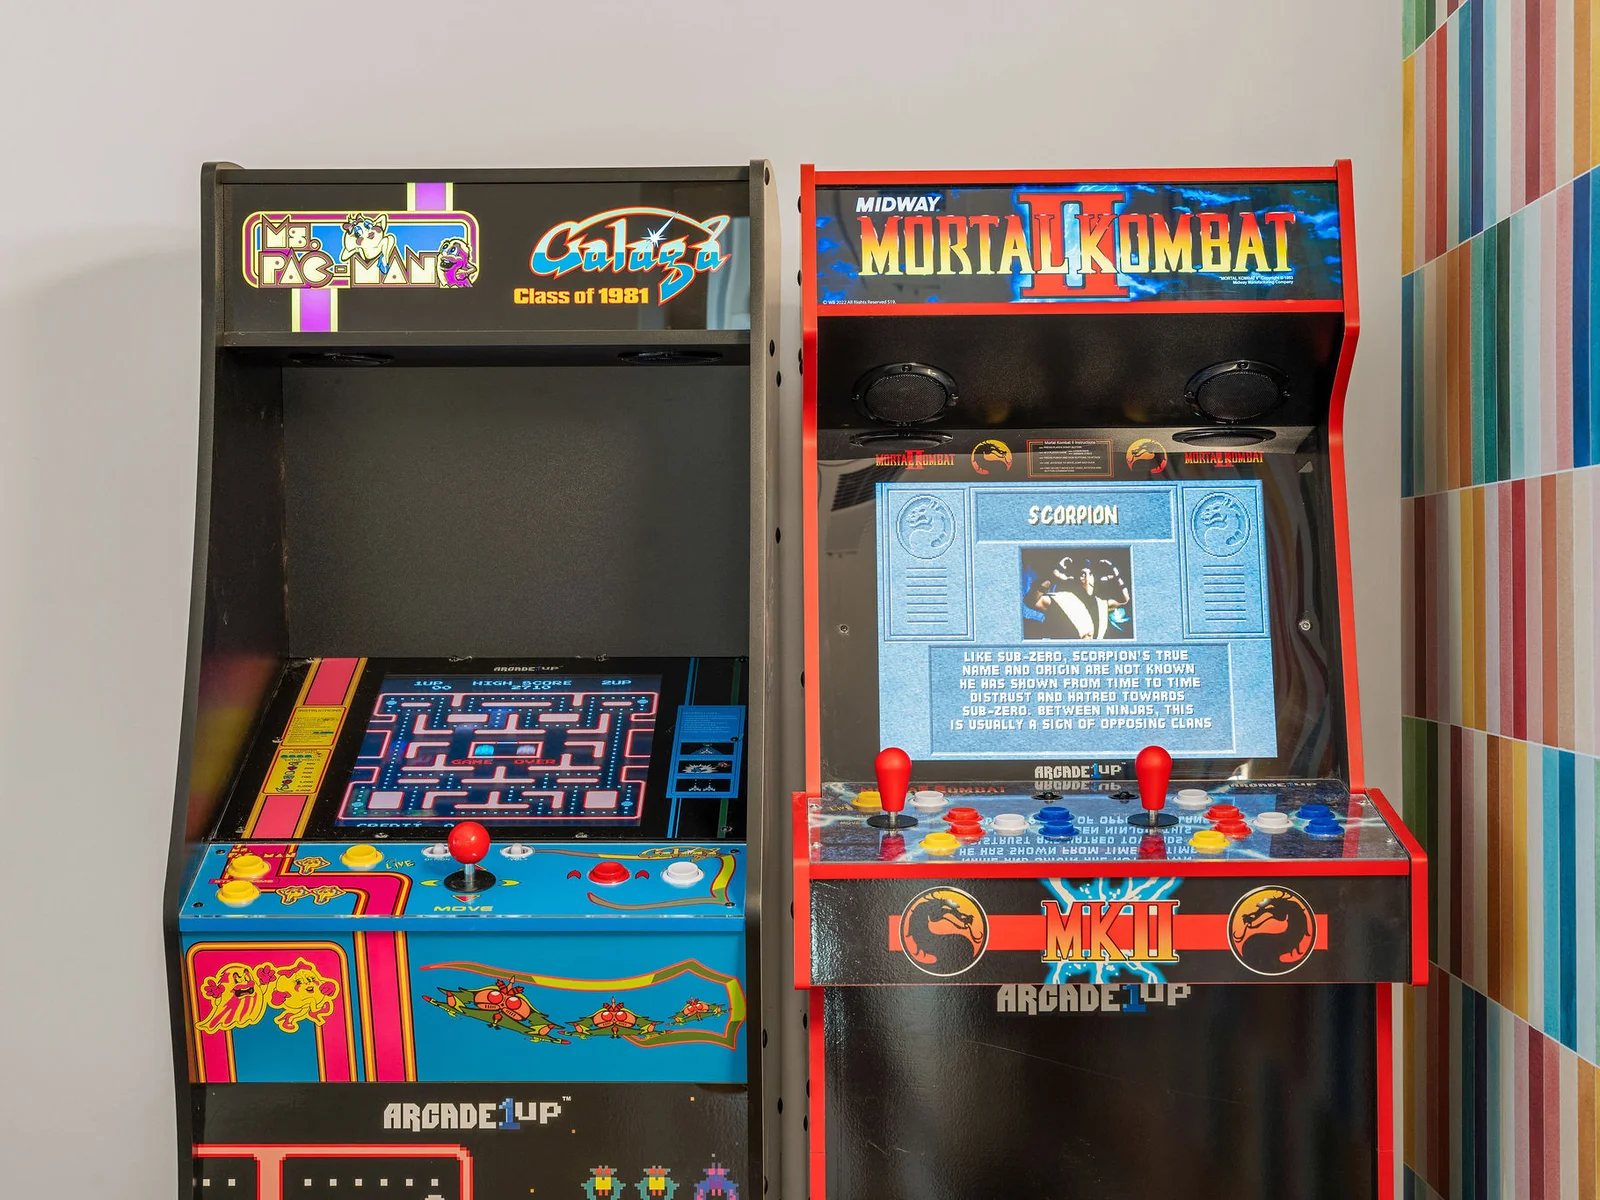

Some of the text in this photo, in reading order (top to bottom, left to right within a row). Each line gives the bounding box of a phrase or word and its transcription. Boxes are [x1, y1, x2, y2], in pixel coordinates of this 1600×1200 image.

[855, 197, 940, 213] MIDWAY
[857, 211, 1296, 277] MORTAL KOMBAT
[530, 206, 731, 306] Galaga
[258, 245, 439, 288] PAC-MAN
[514, 287, 649, 306] Class of 1981
[875, 453, 956, 466] MORTAL KOMBAT
[1184, 451, 1265, 464] MORTAL KOMBAT
[1027, 504, 1120, 526] SCORPION
[963, 650, 1189, 664] LIKE SUB-ZERO, SCORPION'S TRUE
[962, 663, 1195, 676] NAME AND ORIGIN ARE NOT KNOWN
[960, 677, 1201, 690] HE HAS SHOWN FROM TIME TO TIME
[970, 690, 1185, 703] DISTRUST AND HATRED TOWARDS
[962, 704, 1195, 717] SUB-ZERO. BETWEEN NINJAS, THIS
[950, 718, 1213, 730] IS USUALLY A SIGN OF OPPOSING CLANS
[1034, 762, 1122, 779] ARCADE1UP
[1041, 899, 1180, 963] MKII
[996, 984, 1191, 1015] ARCADE1UP
[383, 1097, 562, 1133] ARCADE1UP
